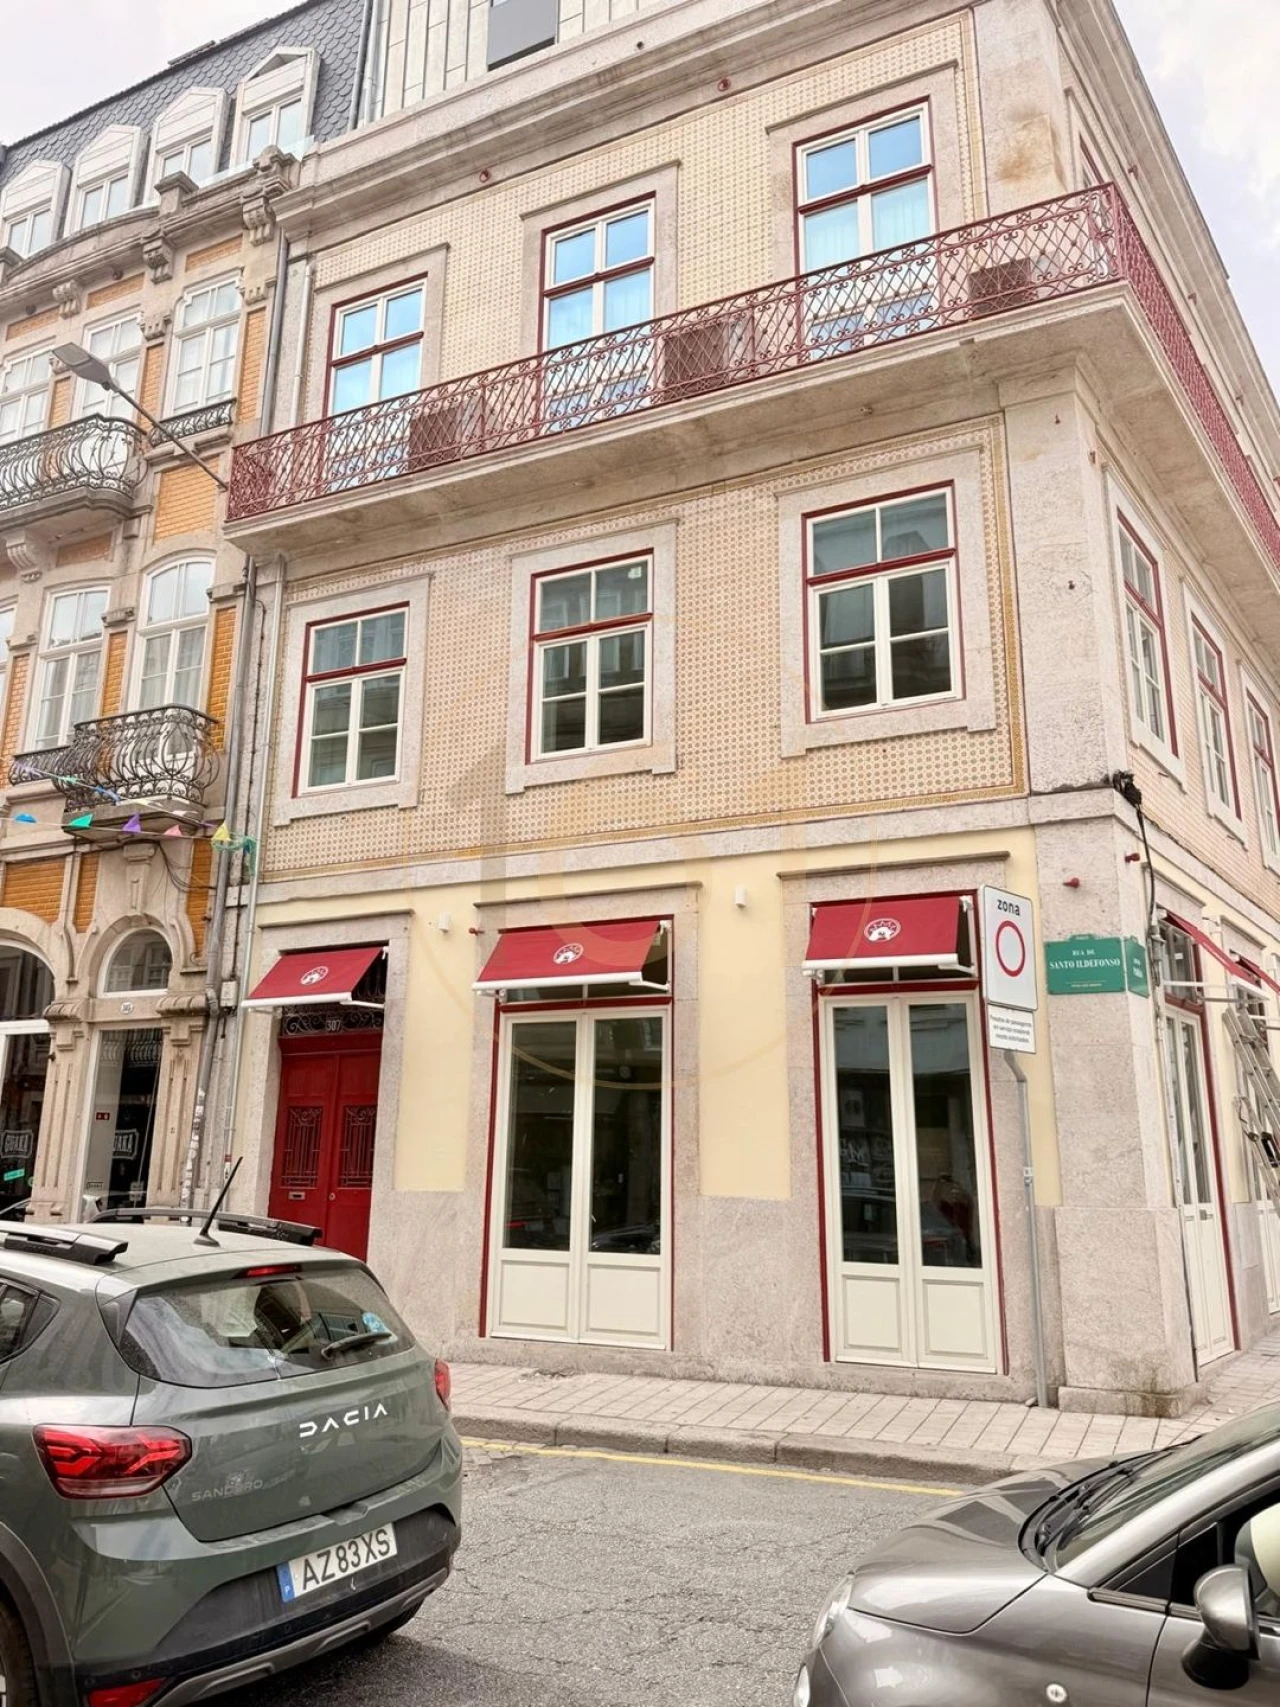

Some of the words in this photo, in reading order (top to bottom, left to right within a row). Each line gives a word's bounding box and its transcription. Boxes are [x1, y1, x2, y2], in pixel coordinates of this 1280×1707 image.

[997, 899, 1020, 916] zona
[1049, 960, 1075, 970] SANTO
[1076, 958, 1121, 968] ILDEFONSO
[299, 1403, 388, 1438] DACIA
[302, 1528, 390, 1590] AZ83XS
